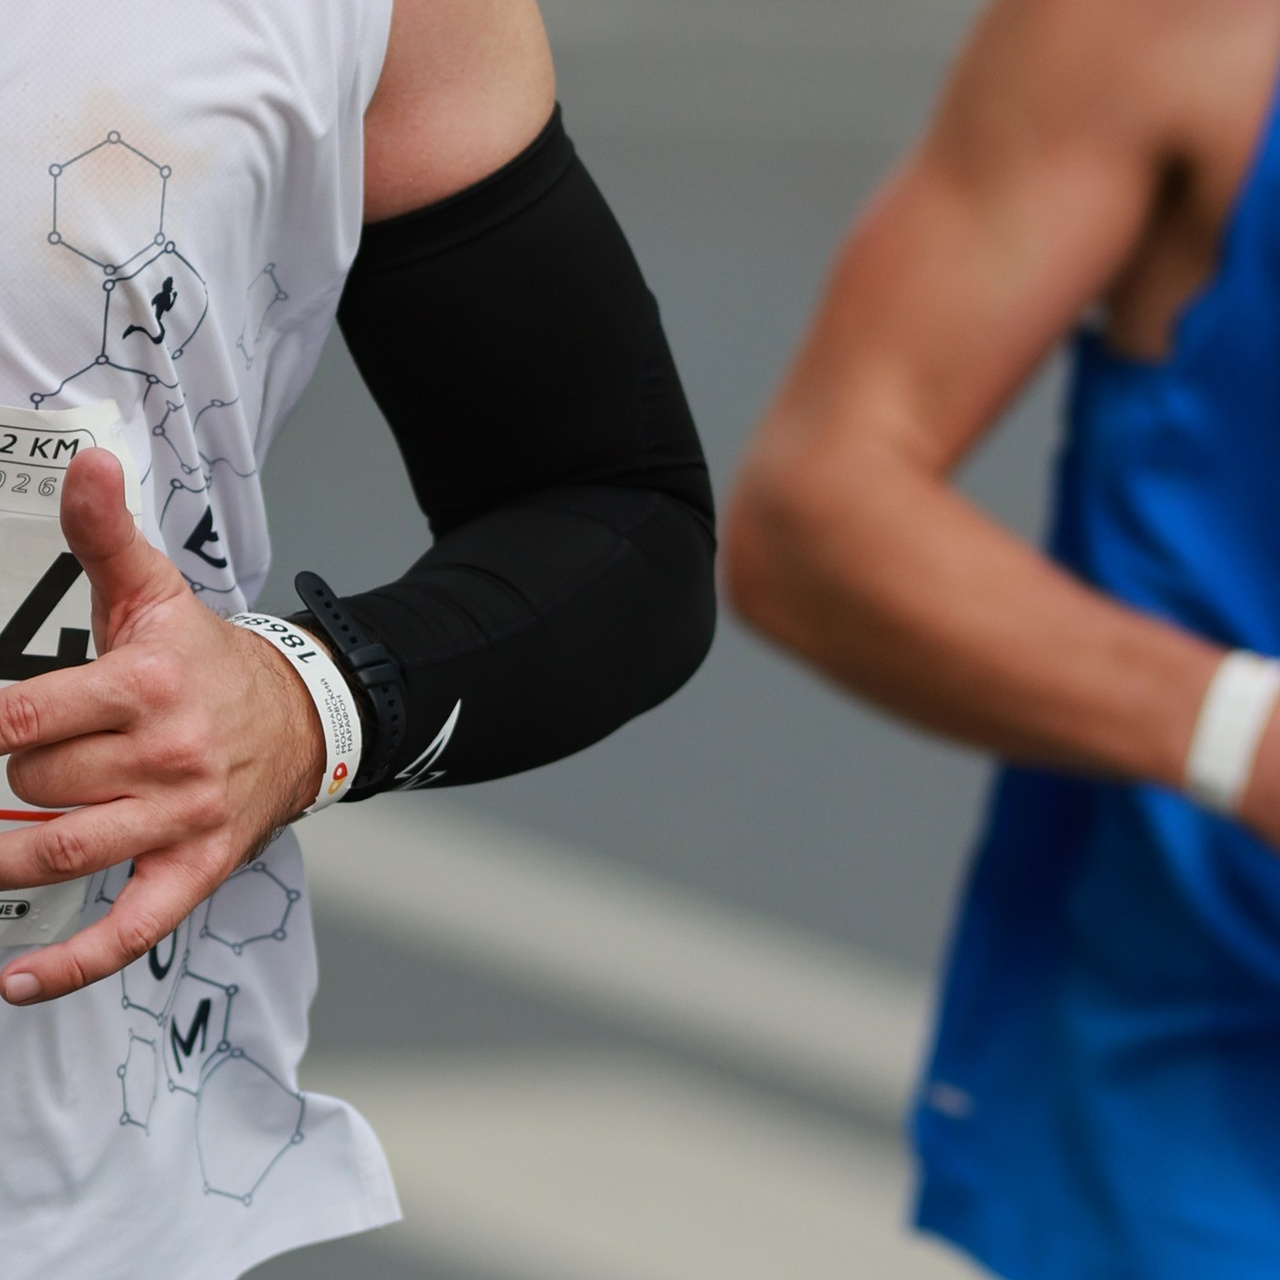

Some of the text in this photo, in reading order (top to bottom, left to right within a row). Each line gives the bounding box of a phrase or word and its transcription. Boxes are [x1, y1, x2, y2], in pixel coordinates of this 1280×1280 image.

[29, 437, 79, 460] КМ
[320, 677, 346, 754] МОСКОВСКИЙ
[323, 697, 340, 756] СБЕРПРАЙМ
[336, 694, 353, 753] МАРАФОН
